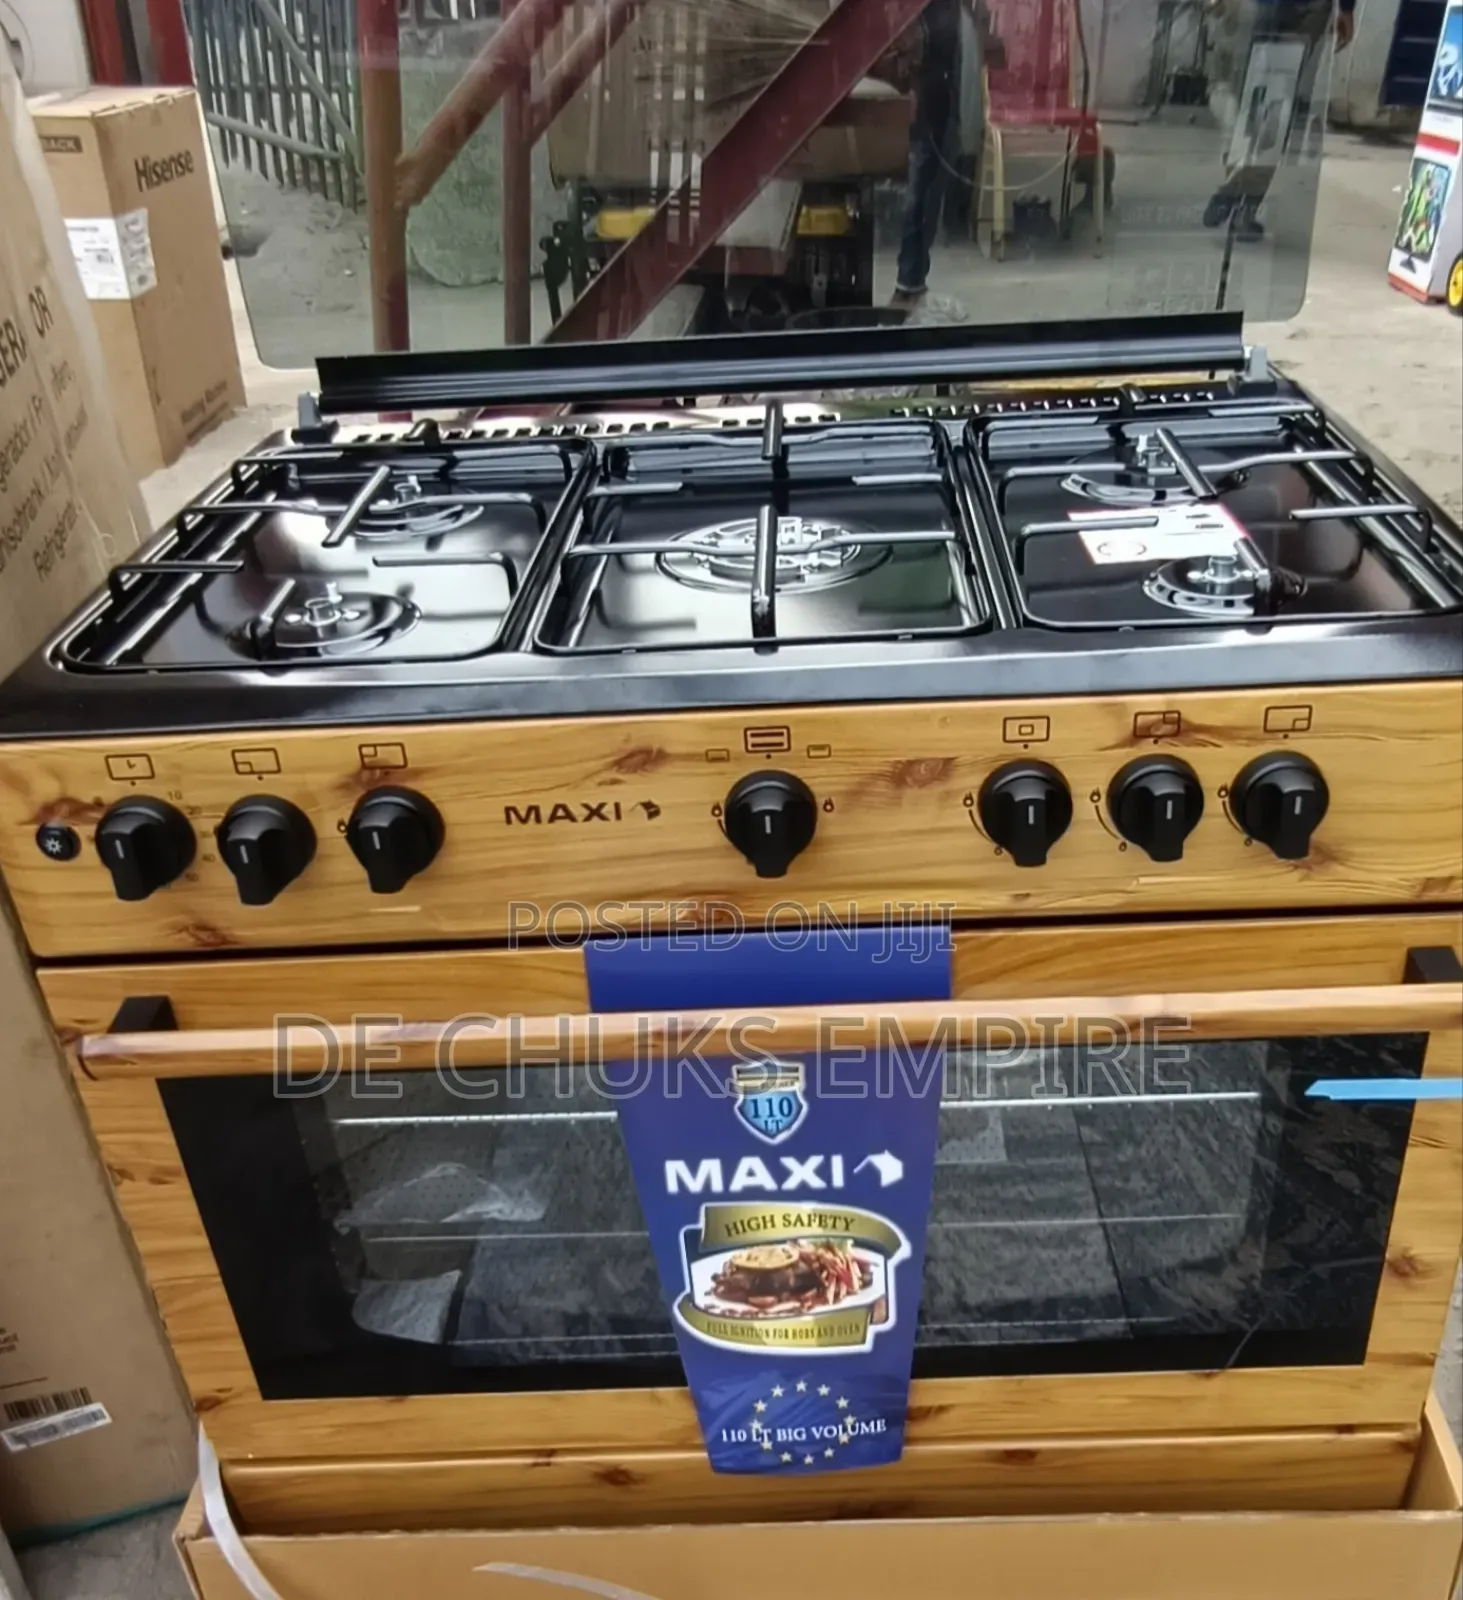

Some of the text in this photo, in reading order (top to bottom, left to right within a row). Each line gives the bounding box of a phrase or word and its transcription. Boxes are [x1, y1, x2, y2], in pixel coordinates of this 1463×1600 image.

[42, 138, 79, 151] ACK
[134, 150, 195, 193] Hisense
[504, 801, 622, 826] MAXI
[750, 1096, 794, 1119] 110
[763, 1119, 784, 1133] LT
[664, 1153, 845, 1194] MAXI
[725, 1212, 856, 1238] HIGH SAFETY
[706, 1322, 860, 1340] FULL IGNITION FOR HOBS AND OVEN
[721, 1418, 887, 1443] 110 LT BIG VOLUME
